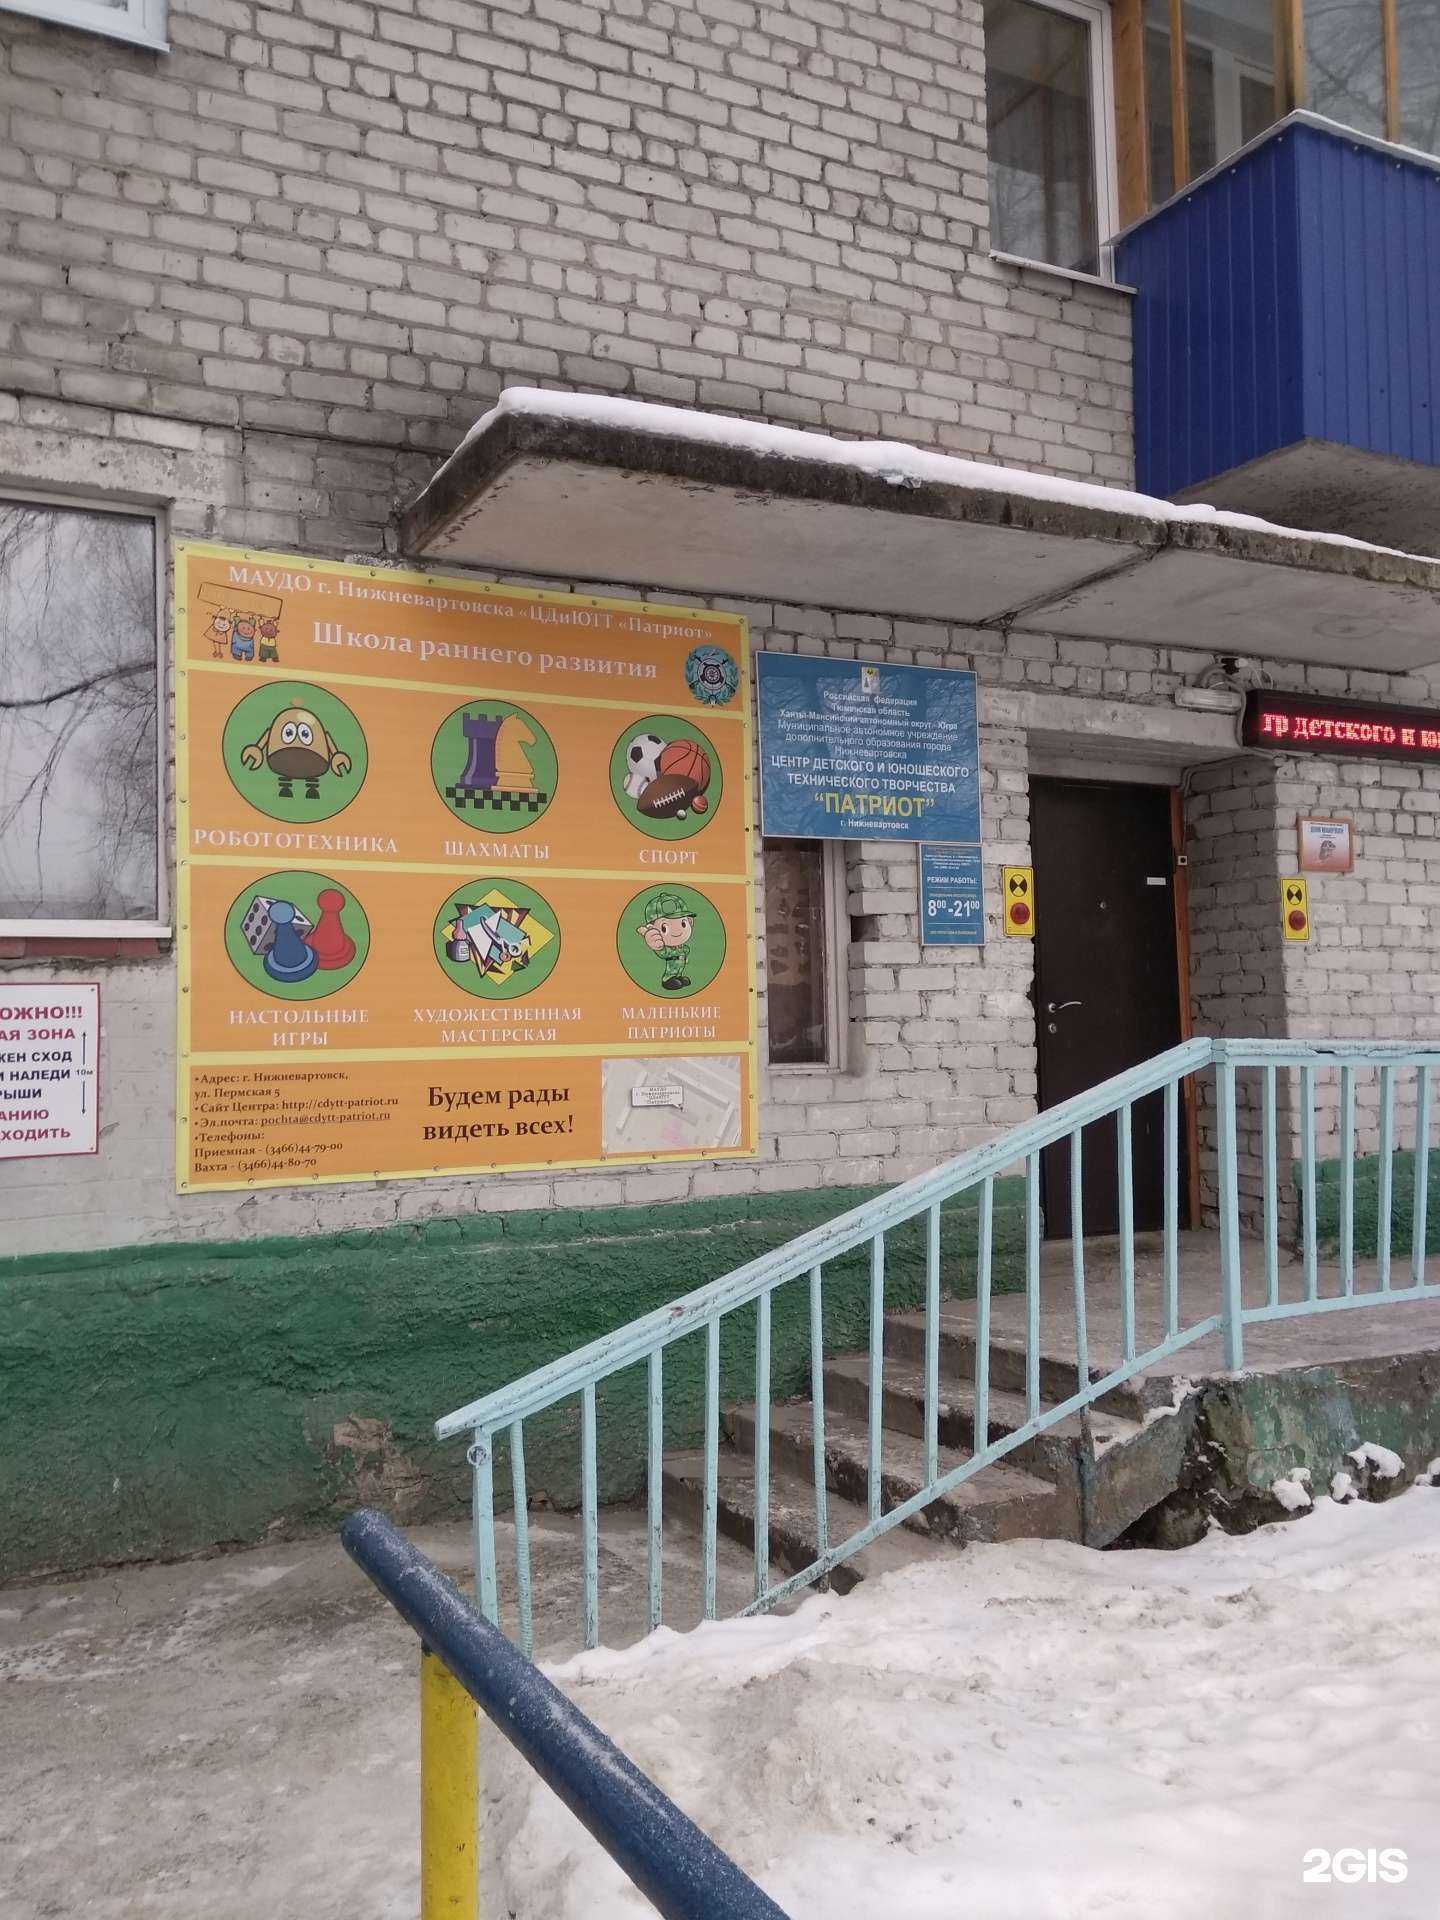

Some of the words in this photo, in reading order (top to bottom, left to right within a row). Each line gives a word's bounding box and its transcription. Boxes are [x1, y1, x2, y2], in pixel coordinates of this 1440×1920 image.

[229, 565, 312, 593] МАУДО
[318, 580, 332, 593] г.
[338, 579, 514, 617] Нижневартовска
[619, 617, 712, 639] «Патриот»
[312, 621, 412, 654] Школа
[420, 639, 532, 666] раннего
[539, 653, 657, 678] развития
[778, 719, 852, 734] Муниципальное
[853, 727, 905, 738] автономное
[907, 730, 959, 741] учреждение
[1294, 717, 1396, 744] детского
[1402, 728, 1416, 746] и
[785, 732, 864, 746] дополнительного
[866, 738, 921, 750] образования
[923, 741, 952, 752] города
[834, 745, 907, 760] Нижневартовска
[771, 754, 810, 768] ЦЕНТР
[813, 757, 875, 772] ДЕТСКОГО
[877, 762, 885, 773] И
[888, 762, 969, 778] ЮНОШЕСКОГО
[787, 772, 880, 789] ТЕХНИЧЕСКОГО
[882, 778, 956, 793] ТВОРЧЕСТВА
[848, 819, 909, 830] Нижневартовск
[194, 828, 397, 853] РОБОТОТЕХНИКА
[444, 840, 550, 860] ШАХМАТЫ
[639, 849, 698, 865] СПОРТ
[927, 876, 949, 884] РЕЖИМ
[0, 1006, 83, 1020] ОЖНО!!!
[229, 1008, 369, 1025] НАСТОЛЬНЫЕ
[413, 1007, 582, 1025] ХУДОЖЕСТВЕННАЯ
[622, 1006, 721, 1020] МАЛЕНЬКИЕ
[27, 1028, 76, 1041] ЗОНА
[273, 1031, 328, 1046] ИГРЫ
[441, 1028, 557, 1043] МАСТЕРСКАЯ
[627, 1026, 716, 1040] ПАТРИОТЫ
[31, 1051, 73, 1063] СХОД
[10, 1069, 71, 1081] НАЛЕДИ
[201, 1073, 240, 1084] Адрес:
[242, 1074, 251, 1082] г.
[194, 1089, 210, 1099] ул.
[214, 1087, 272, 1099] Пермская
[274, 1089, 281, 1098] 5
[428, 1085, 501, 1111] Будем
[508, 1087, 570, 1110] рады
[201, 1102, 230, 1113] Сайт
[232, 1101, 280, 1113] Центра:
[281, 1097, 399, 1110] http://cdytt-patriot.ru
[261, 1112, 391, 1126] pochta@cdytt-patriot.ru
[1, 1128, 71, 1142] ХОДИТЬ
[422, 1120, 510, 1142] видеть
[515, 1115, 574, 1136] всех!
[199, 1131, 265, 1143] Телефоны:
[194, 1146, 256, 1158] Приемная
[265, 1142, 343, 1155] (3466)44-79-00
[194, 1162, 228, 1173] Вахта
[238, 1158, 317, 1172] (3466)44-80-70
